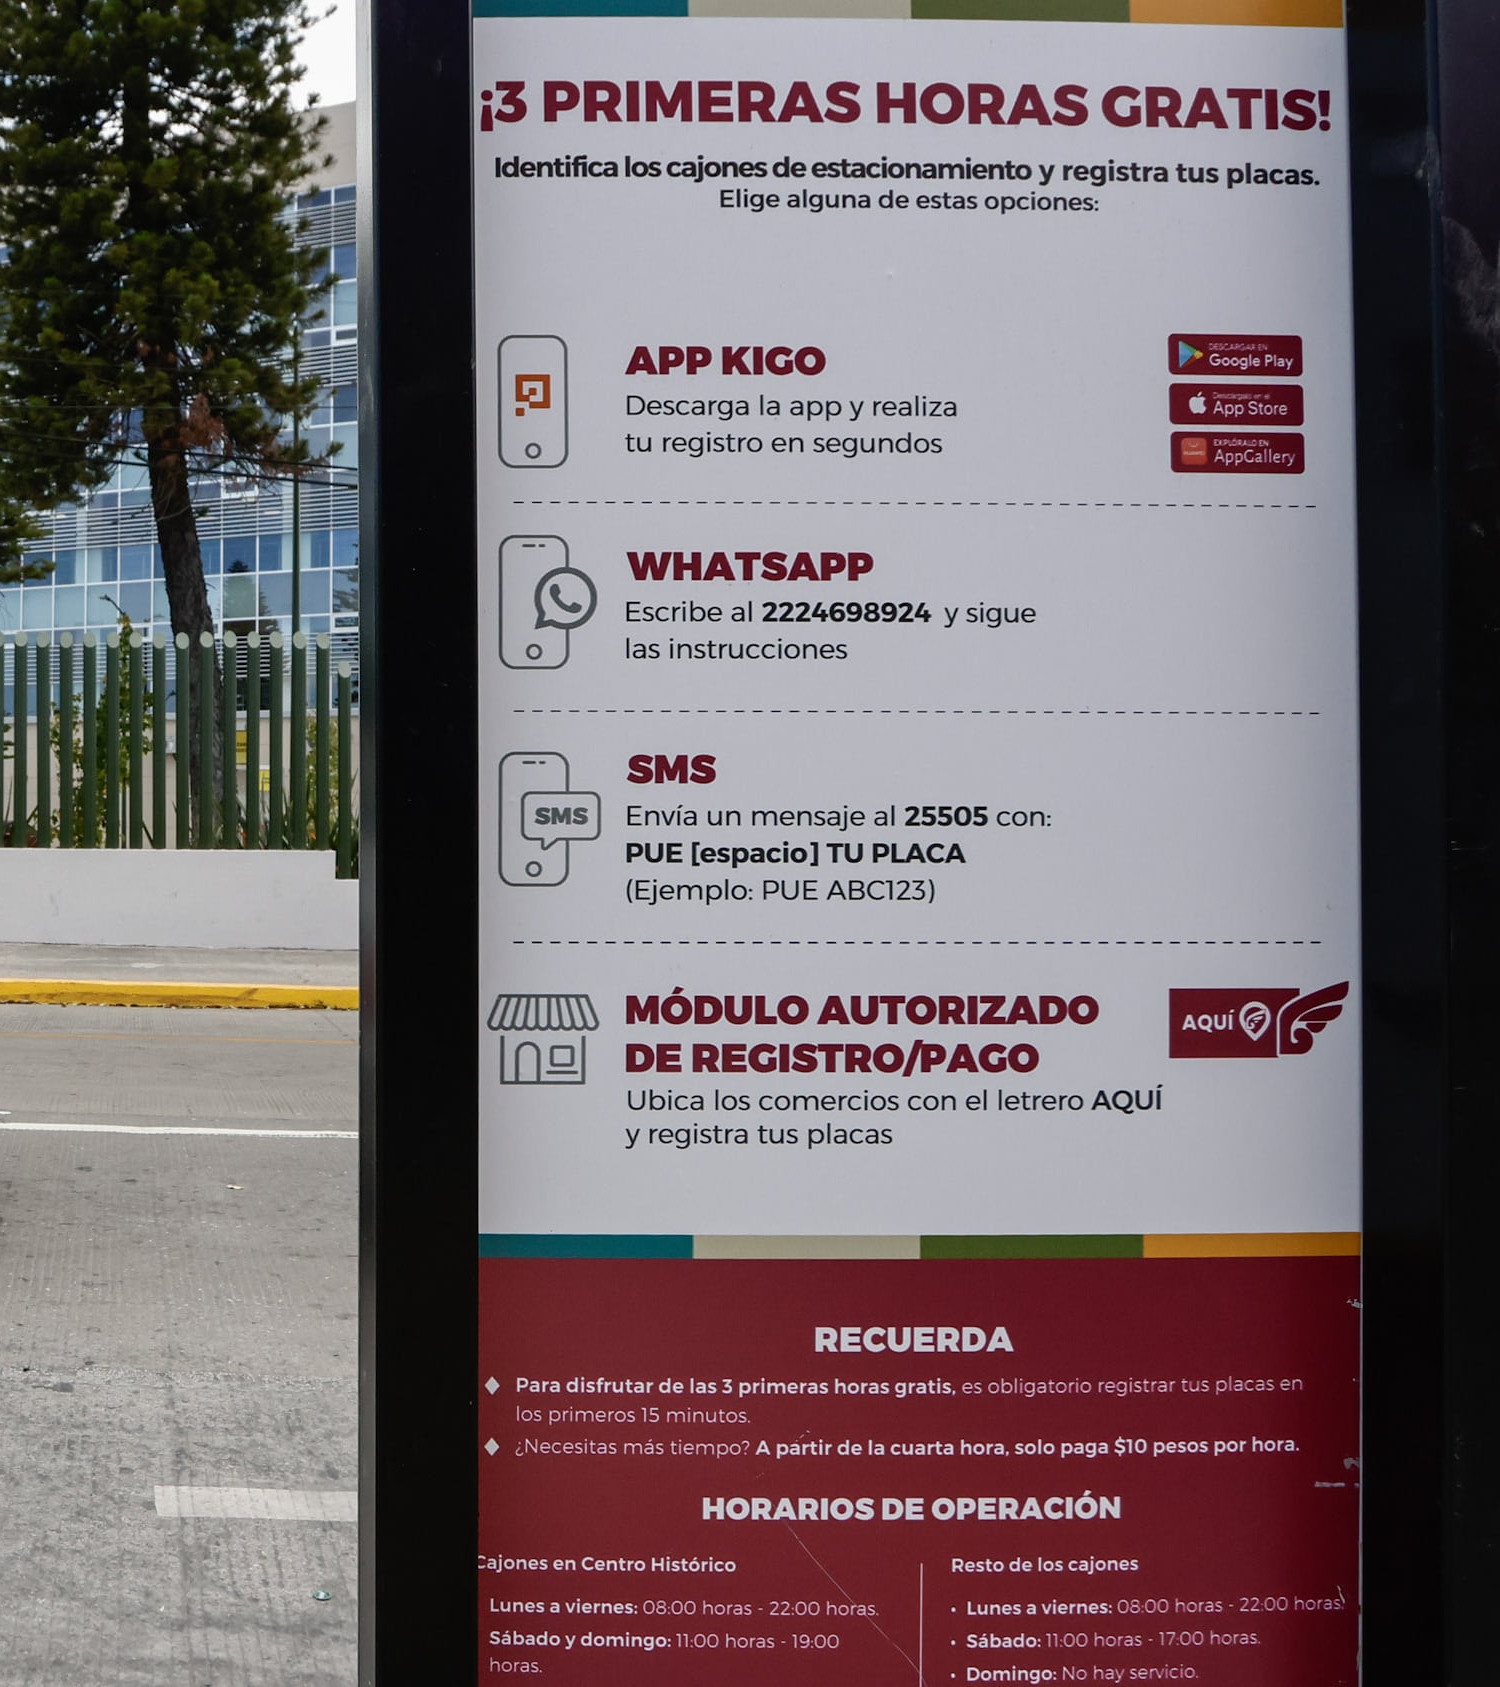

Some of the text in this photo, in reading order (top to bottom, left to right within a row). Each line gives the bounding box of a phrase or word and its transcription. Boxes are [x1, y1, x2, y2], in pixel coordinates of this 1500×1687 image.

[479, 79, 1332, 133] ¡3 PRIMERAS HORAS GRATIS!
[494, 154, 1321, 190] Identifica los cajones de estacionamiento y registra tus placas.
[719, 187, 1100, 216] Elige alguna de estas opciones:
[624, 345, 827, 377] APP KIGO
[1208, 353, 1295, 371] Google Play
[625, 393, 958, 423] Descarga la app y realiza
[1212, 400, 1288, 418] App Store
[624, 430, 944, 459] tu registro en segundos
[1213, 448, 1297, 468] AppGallery
[1258, 439, 1270, 448] EN
[625, 550, 875, 582] WHATSAPP
[625, 599, 1037, 629] Escribe al 2224698924 y sigue
[625, 636, 849, 660] las instrucciones
[625, 753, 717, 785] SMS
[533, 806, 589, 826] SMS
[626, 803, 1052, 833] Envía un mensaje al 25505 con:
[625, 840, 967, 870] PUE [espacio] TU PLACA
[625, 877, 936, 907] (Ejemplo: PUE ABC123)
[625, 985, 1100, 1026] MÓDULO AUTORIZADO
[1181, 1008, 1236, 1034] AQUÍ
[625, 1038, 1040, 1078] DE REGISTRO/PAGO
[627, 1083, 1164, 1115] Ubica los comercios con el letrero AQUÍ
[624, 1122, 894, 1151] y registra tus placas
[814, 1325, 1015, 1354] RECUERDA
[515, 1375, 1304, 1399] Para disfrutar de las 3 primeras horas gratis, es obligatorio registrar tus placas en
[515, 1404, 752, 1426] los primeros 15 minutos.
[514, 1435, 1300, 1460] ¿Necesitas más tiempo? A partir de la cuarta hora, solo paga $10 pesos por hora.
[701, 1489, 1122, 1521] HORARIOS DE OPERACIÓN
[477, 1553, 737, 1574] Cajones en Centro Histórico
[951, 1555, 1140, 1576] Resto de los cajones
[489, 1597, 880, 1617] Lunes a viernes: 08:00 horas 22:00 horas.
[488, 1629, 840, 1652] Sábado y domingo: 11:00 horas 19:00
[965, 1629, 1261, 1649] Sábado: 11:00 horas 17:00 horas.
[966, 1663, 1199, 1685] Domingo: No hay servicio.
